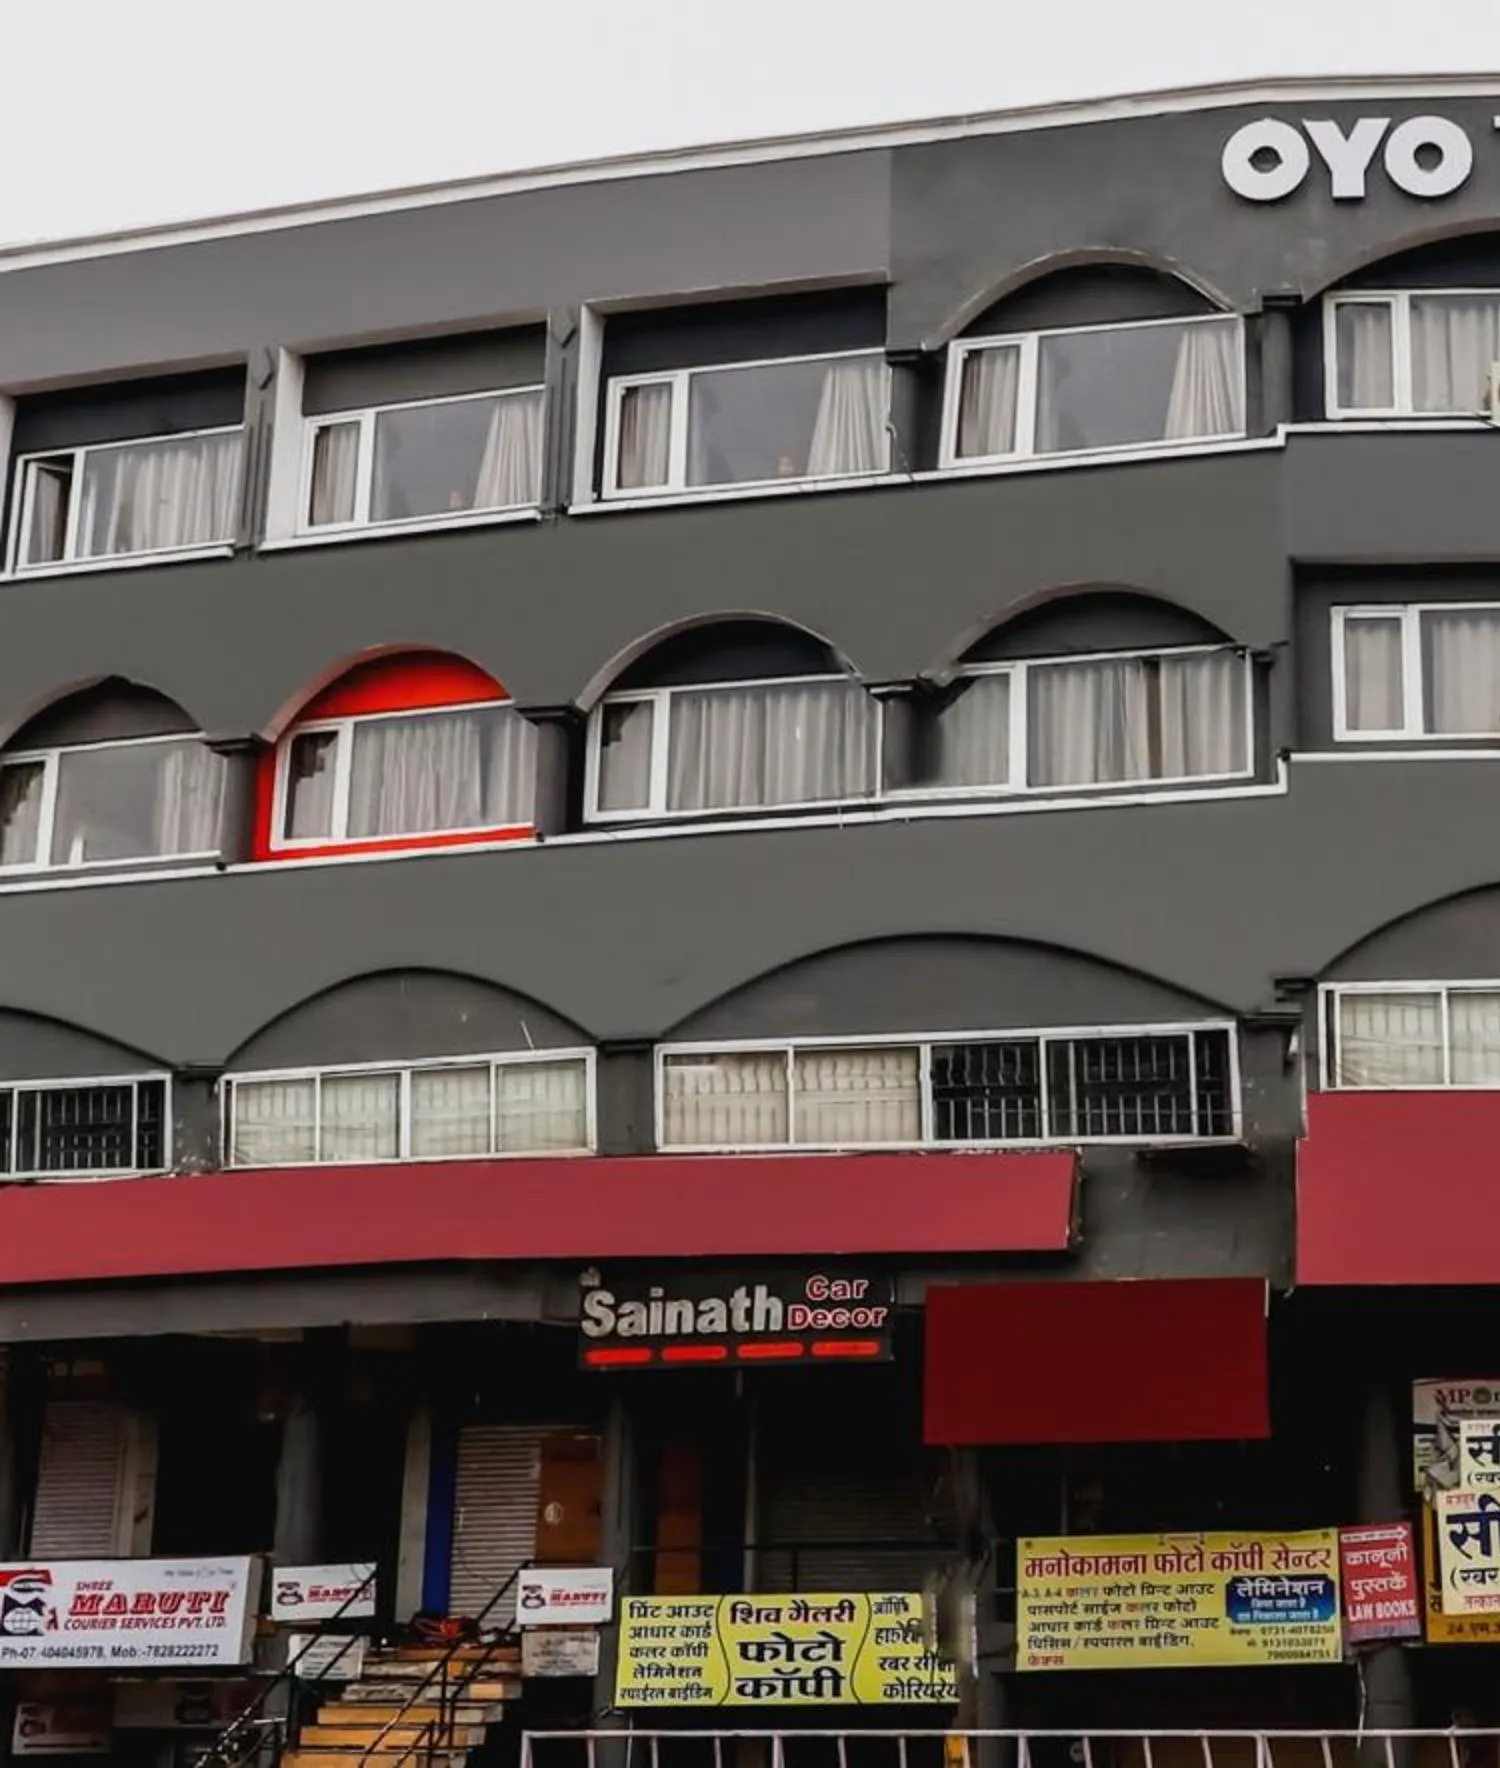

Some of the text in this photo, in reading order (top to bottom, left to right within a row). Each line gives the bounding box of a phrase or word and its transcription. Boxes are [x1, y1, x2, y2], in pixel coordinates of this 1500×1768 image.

[1221, 115, 1474, 201] OYO
[805, 1274, 871, 1301] Car
[580, 1285, 784, 1338] Sainath
[787, 1303, 889, 1331] Decor
[1024, 1547, 1147, 1578] मनोकामना
[1153, 1543, 1204, 1574] फोटो
[1210, 1540, 1264, 1572] कॉपी
[1345, 1541, 1408, 1568] कानूनी
[76, 1580, 114, 1591] SHREE
[1103, 1581, 1137, 1598] फोटो
[1450, 1566, 1500, 1591] (रबर
[68, 1591, 231, 1616] MARUTI
[666, 1604, 716, 1619] आउट
[730, 1598, 857, 1625] शिव गैलरी
[1348, 1602, 1374, 1622] LAW
[1376, 1599, 1416, 1619] BOOKS
[63, 1618, 118, 1631] COURIER
[120, 1617, 177, 1630] SERVICES
[629, 1620, 713, 1640] आधार कार्ड
[629, 1645, 668, 1659] कलर
[736, 1630, 847, 1663] फोटो
[879, 1655, 912, 1672] रबर
[734, 1666, 846, 1699] कॉपी
